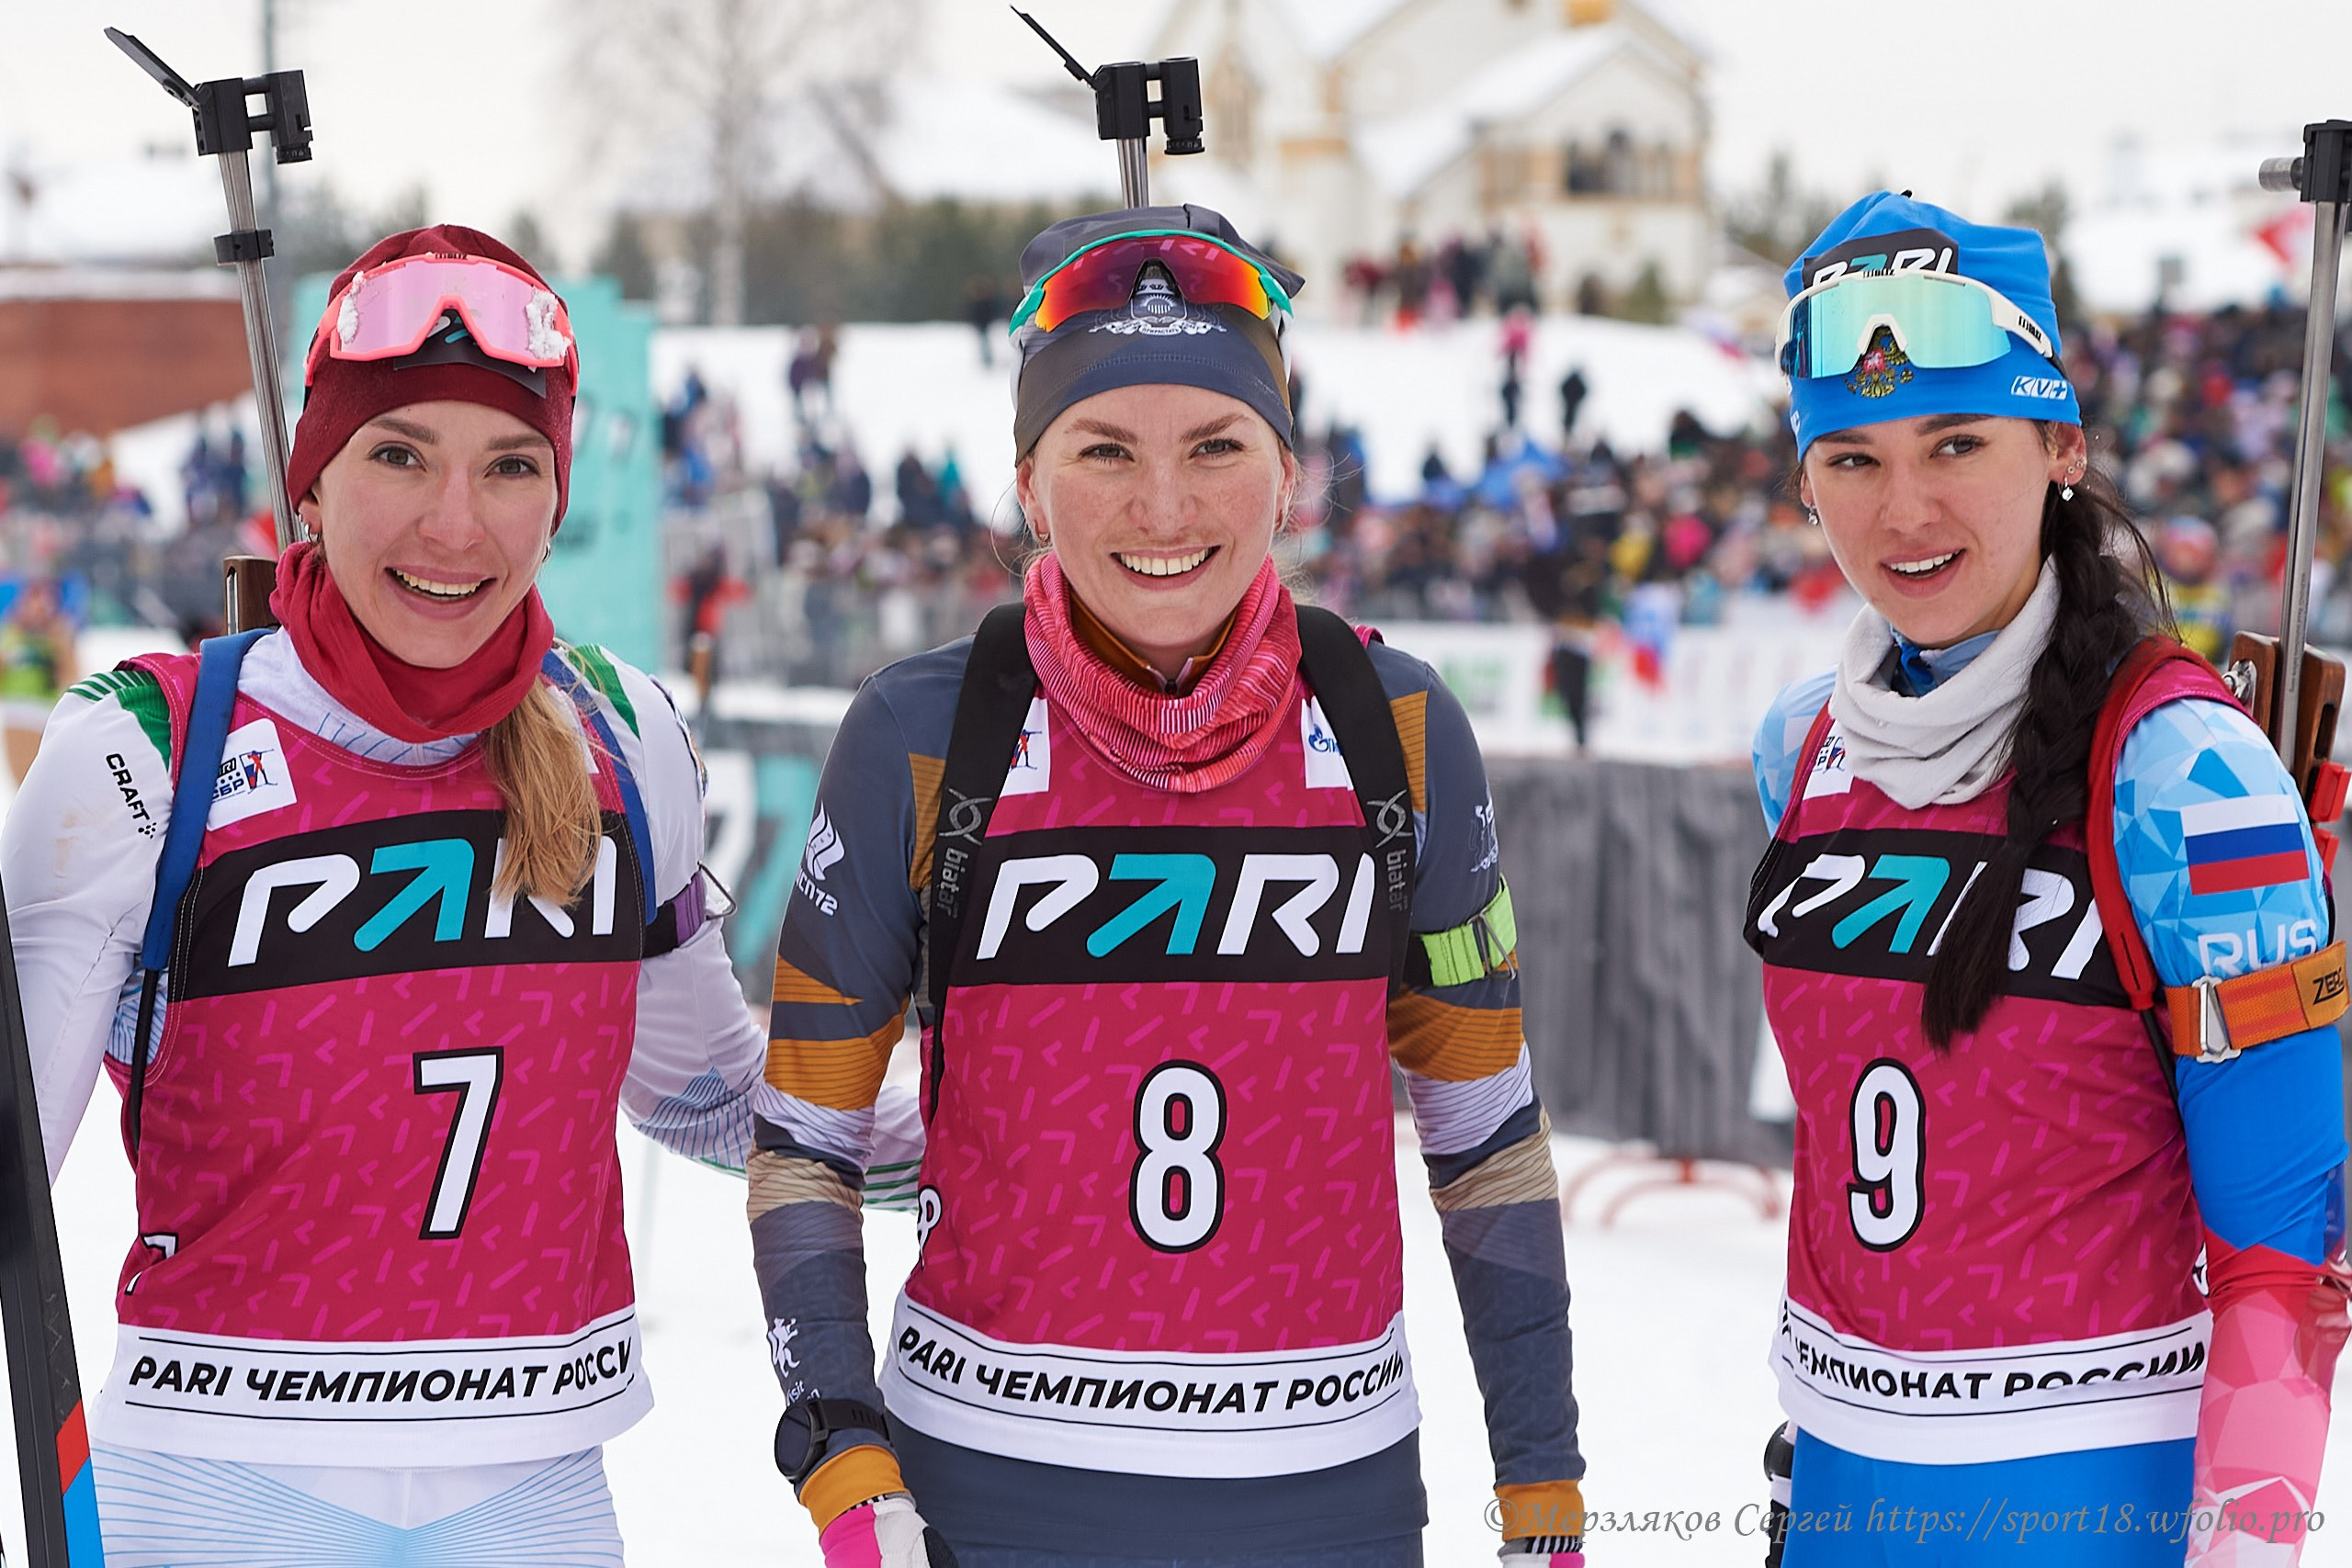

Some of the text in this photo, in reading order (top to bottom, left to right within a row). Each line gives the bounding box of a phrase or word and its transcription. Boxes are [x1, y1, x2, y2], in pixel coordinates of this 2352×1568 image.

[106, 753, 151, 820] CRAFT
[976, 852, 1375, 960] PARI
[2198, 919, 2317, 977] RUS
[413, 1046, 504, 1240] 7
[1127, 1058, 1227, 1255] 8
[1846, 1056, 1927, 1253] 9
[129, 1355, 233, 1396] PARI
[246, 1367, 548, 1403] ЧЕМПИОНАТ
[897, 1325, 1405, 1414] PARI ЧЕМПИОНАТ РОССИИ
[1794, 1337, 1993, 1400] ЕМПИОНАТ
